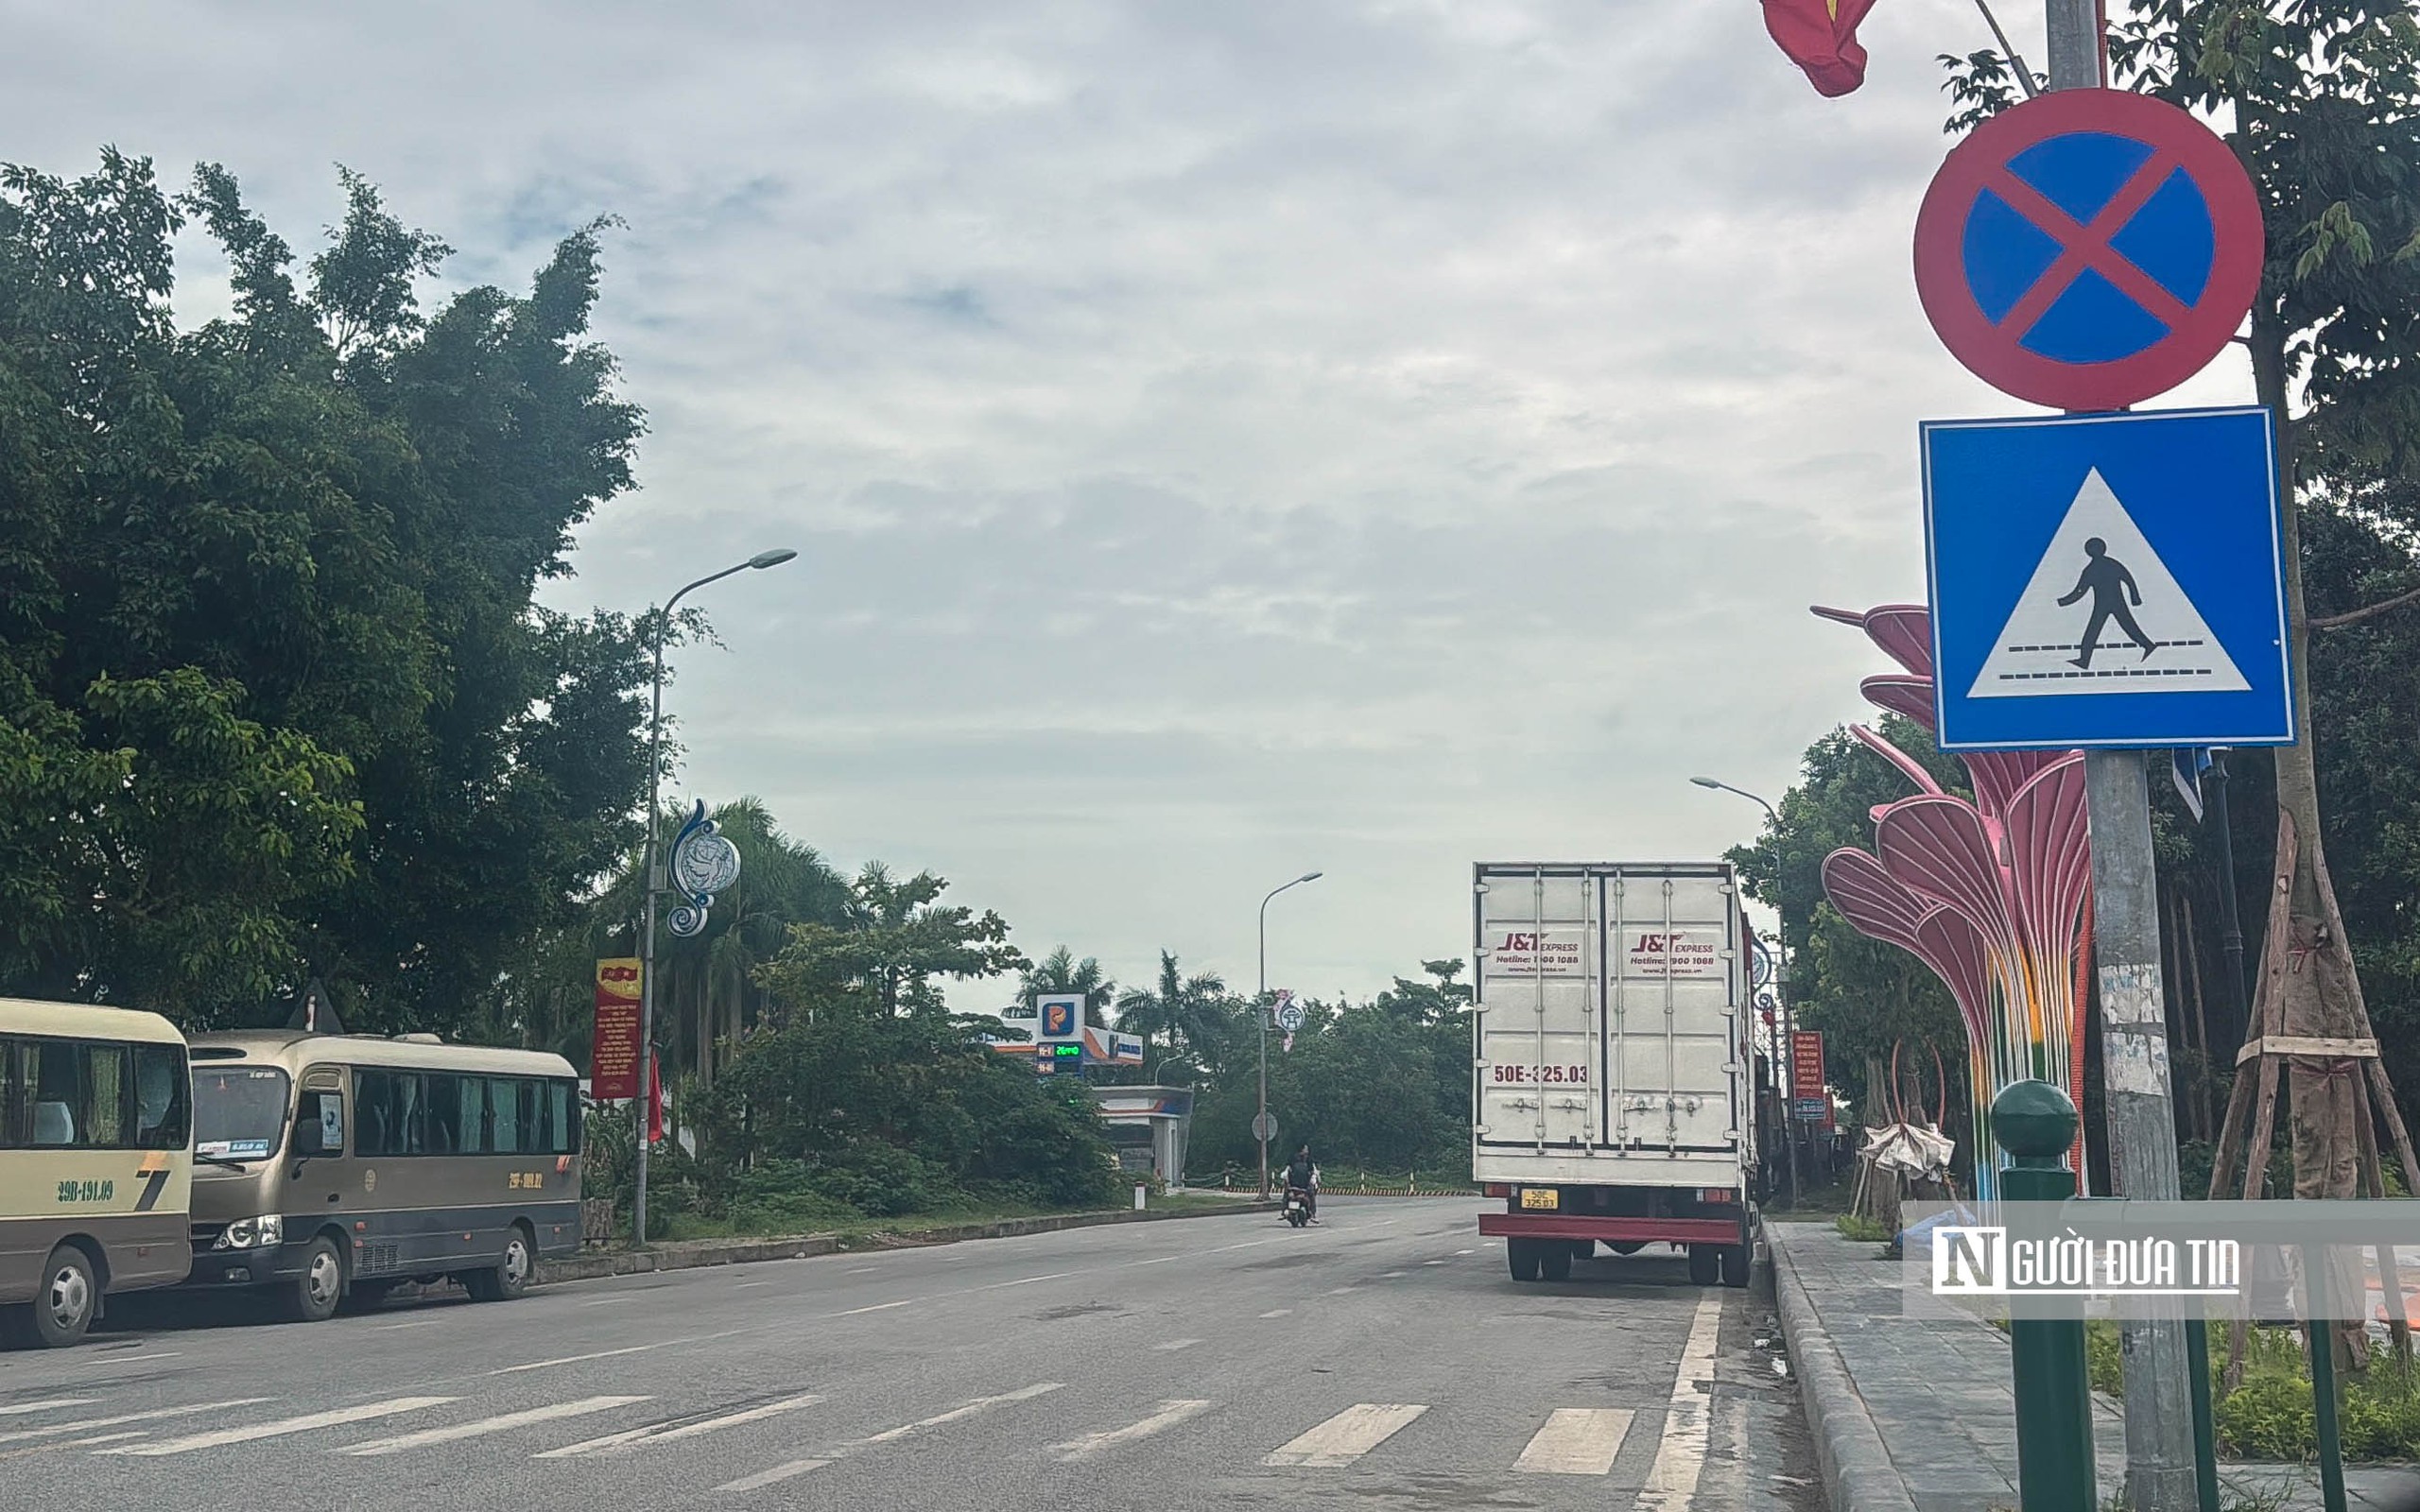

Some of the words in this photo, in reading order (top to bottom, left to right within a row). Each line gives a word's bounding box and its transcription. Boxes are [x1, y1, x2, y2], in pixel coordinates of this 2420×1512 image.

[1496, 933, 1549, 952] J&T
[1541, 943, 1579, 952] EXPRESS
[1631, 934, 1685, 953] J&T
[1496, 955, 1531, 964] Hotline:
[1631, 956, 1666, 965] Hotline:
[1495, 1065, 1588, 1083] 50E-325.03
